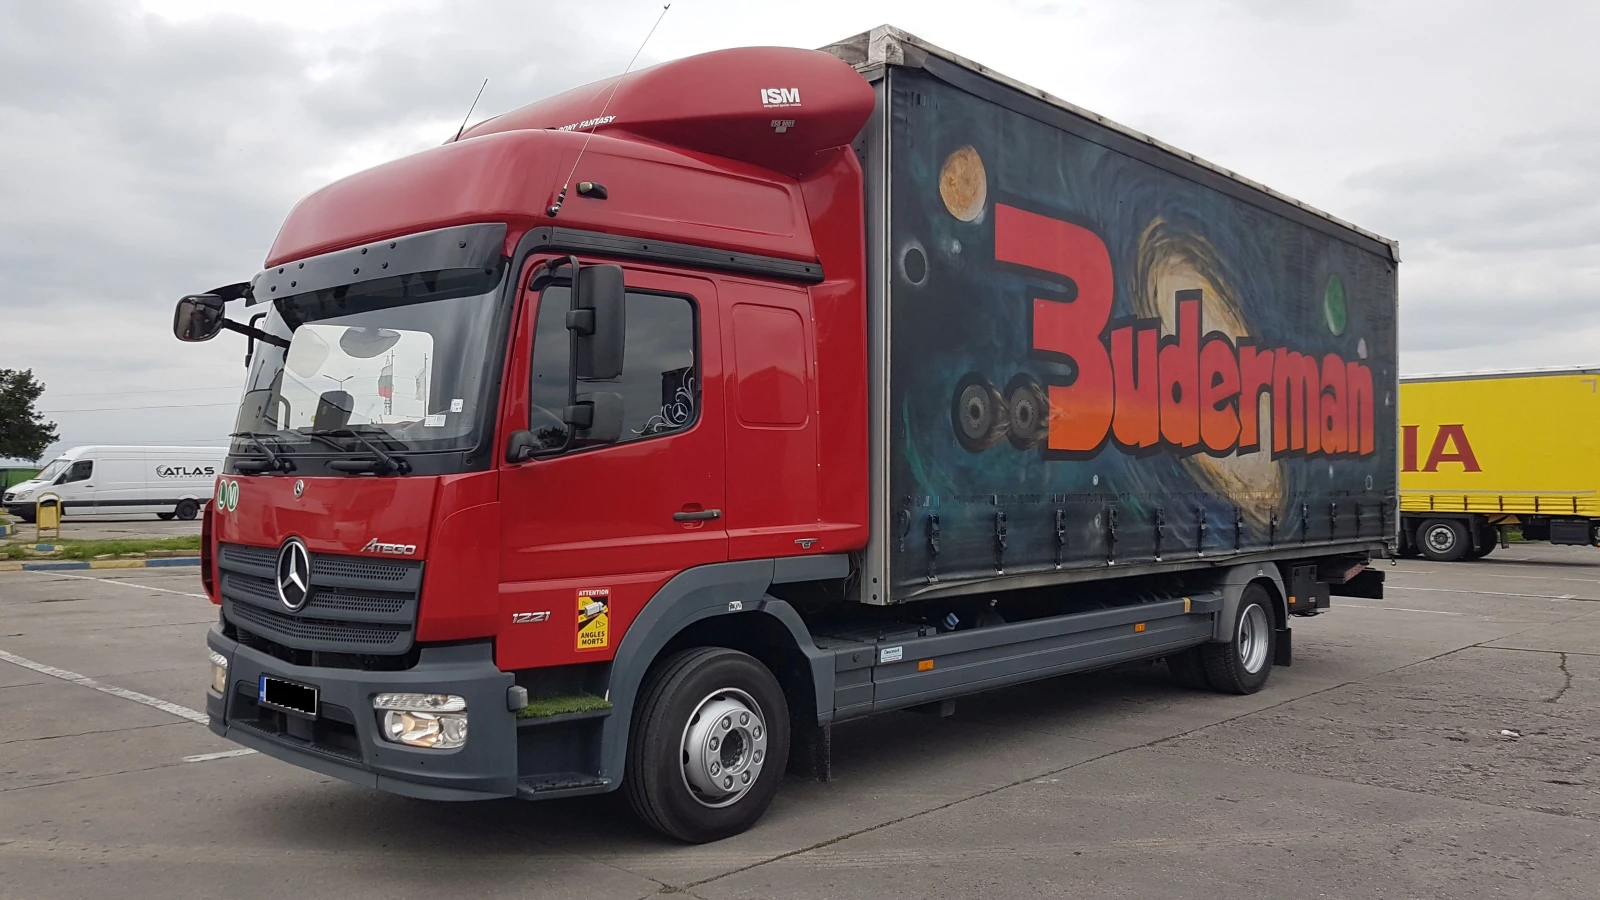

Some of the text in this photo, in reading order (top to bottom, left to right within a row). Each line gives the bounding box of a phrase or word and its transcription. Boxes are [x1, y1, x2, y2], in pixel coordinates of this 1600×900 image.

[761, 87, 801, 104] ISM
[579, 115, 617, 128] FANTASY
[994, 202, 1374, 456] Buderman
[163, 467, 215, 475] ATLAS
[360, 537, 417, 555] ATEGO
[512, 610, 551, 624] 1221
[580, 631, 605, 639] ANGLES
[581, 637, 604, 646] MORTS
